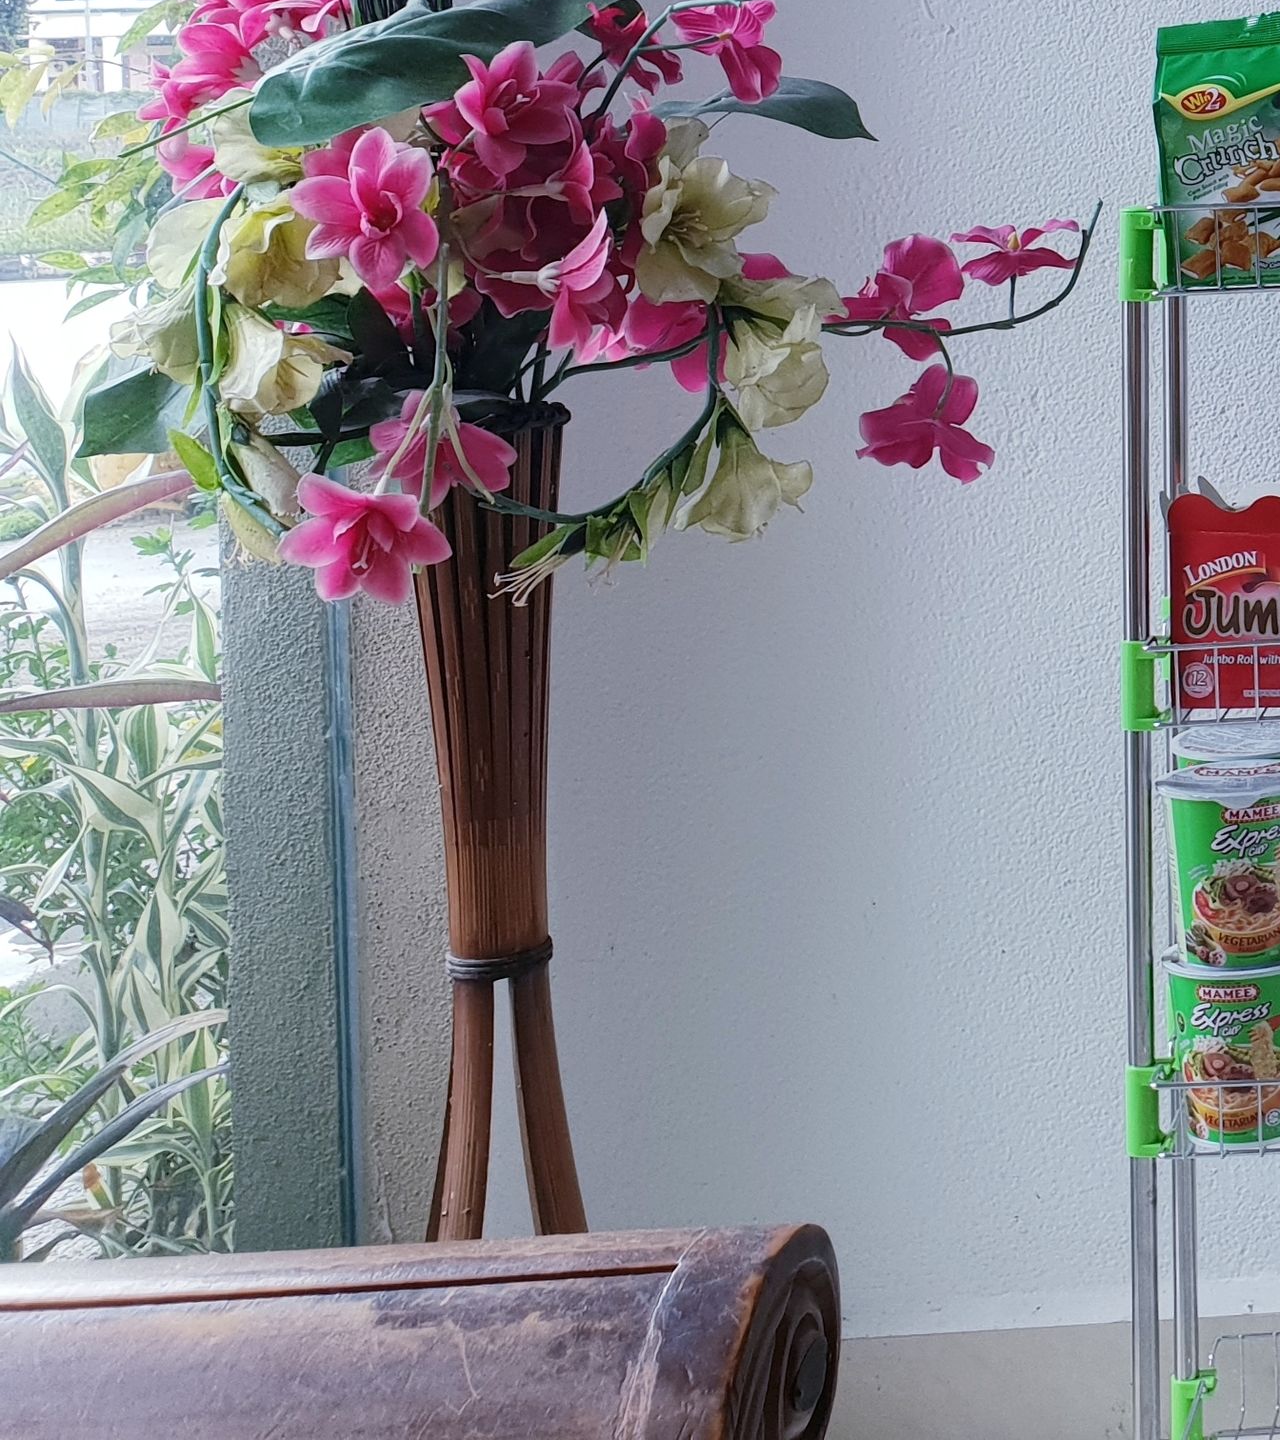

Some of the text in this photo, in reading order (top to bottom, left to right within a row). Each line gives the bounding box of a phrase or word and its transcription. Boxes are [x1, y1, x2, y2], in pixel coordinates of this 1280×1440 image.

[1186, 115, 1264, 154] Magic
[1174, 131, 1280, 186] Crunch
[1183, 551, 1258, 586] LONDON
[1237, 653, 1257, 665] Rol
[1260, 653, 1280, 665] with
[1190, 670, 1207, 686] 12
[1229, 805, 1280, 820] MAMEE
[1203, 988, 1252, 1000] MAMEE
[1191, 1001, 1271, 1036] Express
